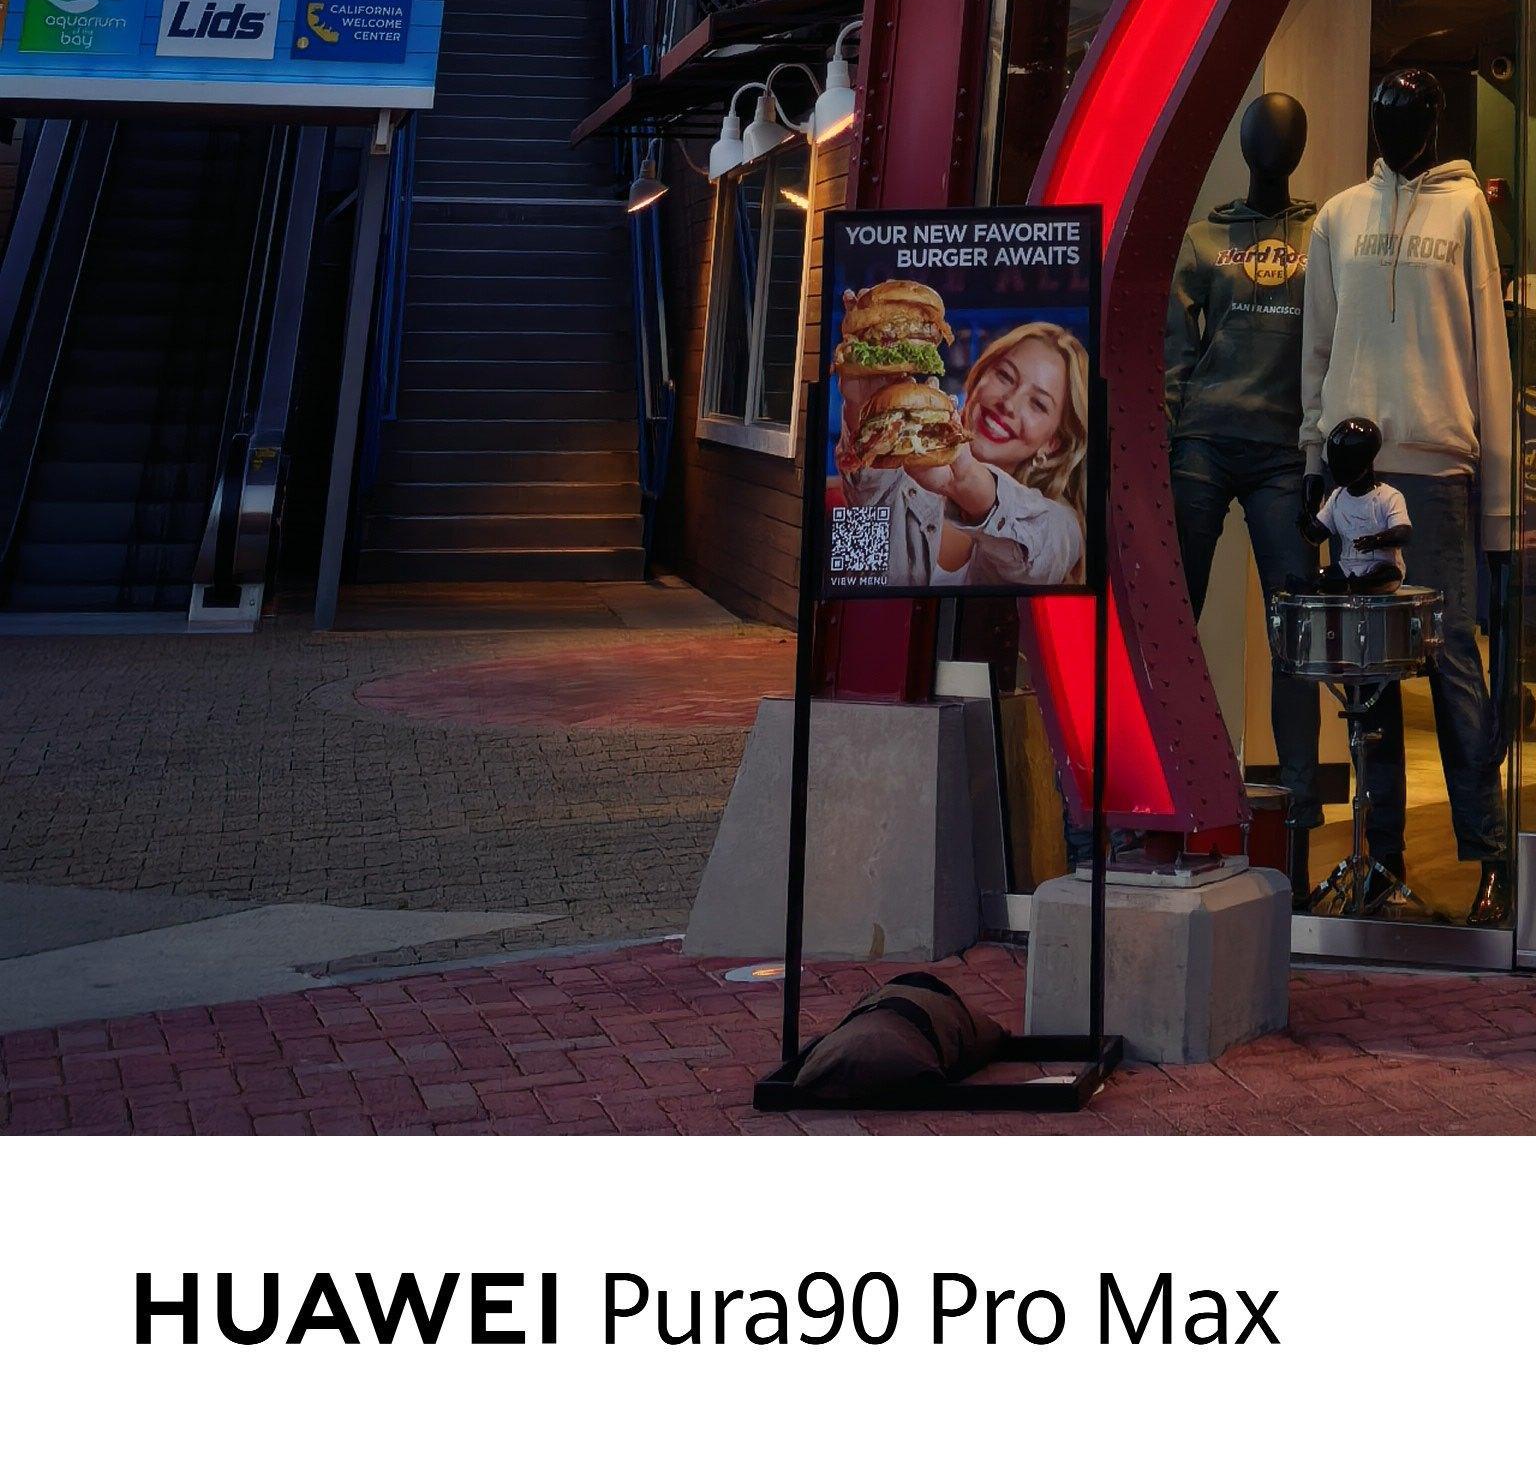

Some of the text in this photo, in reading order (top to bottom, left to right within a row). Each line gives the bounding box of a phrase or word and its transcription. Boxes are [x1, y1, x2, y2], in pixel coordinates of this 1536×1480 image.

[330, 4, 403, 17] CALIFORNIA
[45, 15, 127, 29] aquarium
[166, 1, 266, 40] Lids
[342, 17, 402, 29] WELCOME
[60, 31, 94, 49] bay
[353, 30, 401, 42] CENTER
[845, 222, 1080, 245] YOUR NEW FAVORITE
[897, 246, 1080, 268] BURGER AWAITS
[1408, 235, 1461, 265] ROCK
[1216, 246, 1308, 271] Hard Roc
[1232, 303, 1251, 312] SAN
[830, 576, 888, 586] VIEW MENU
